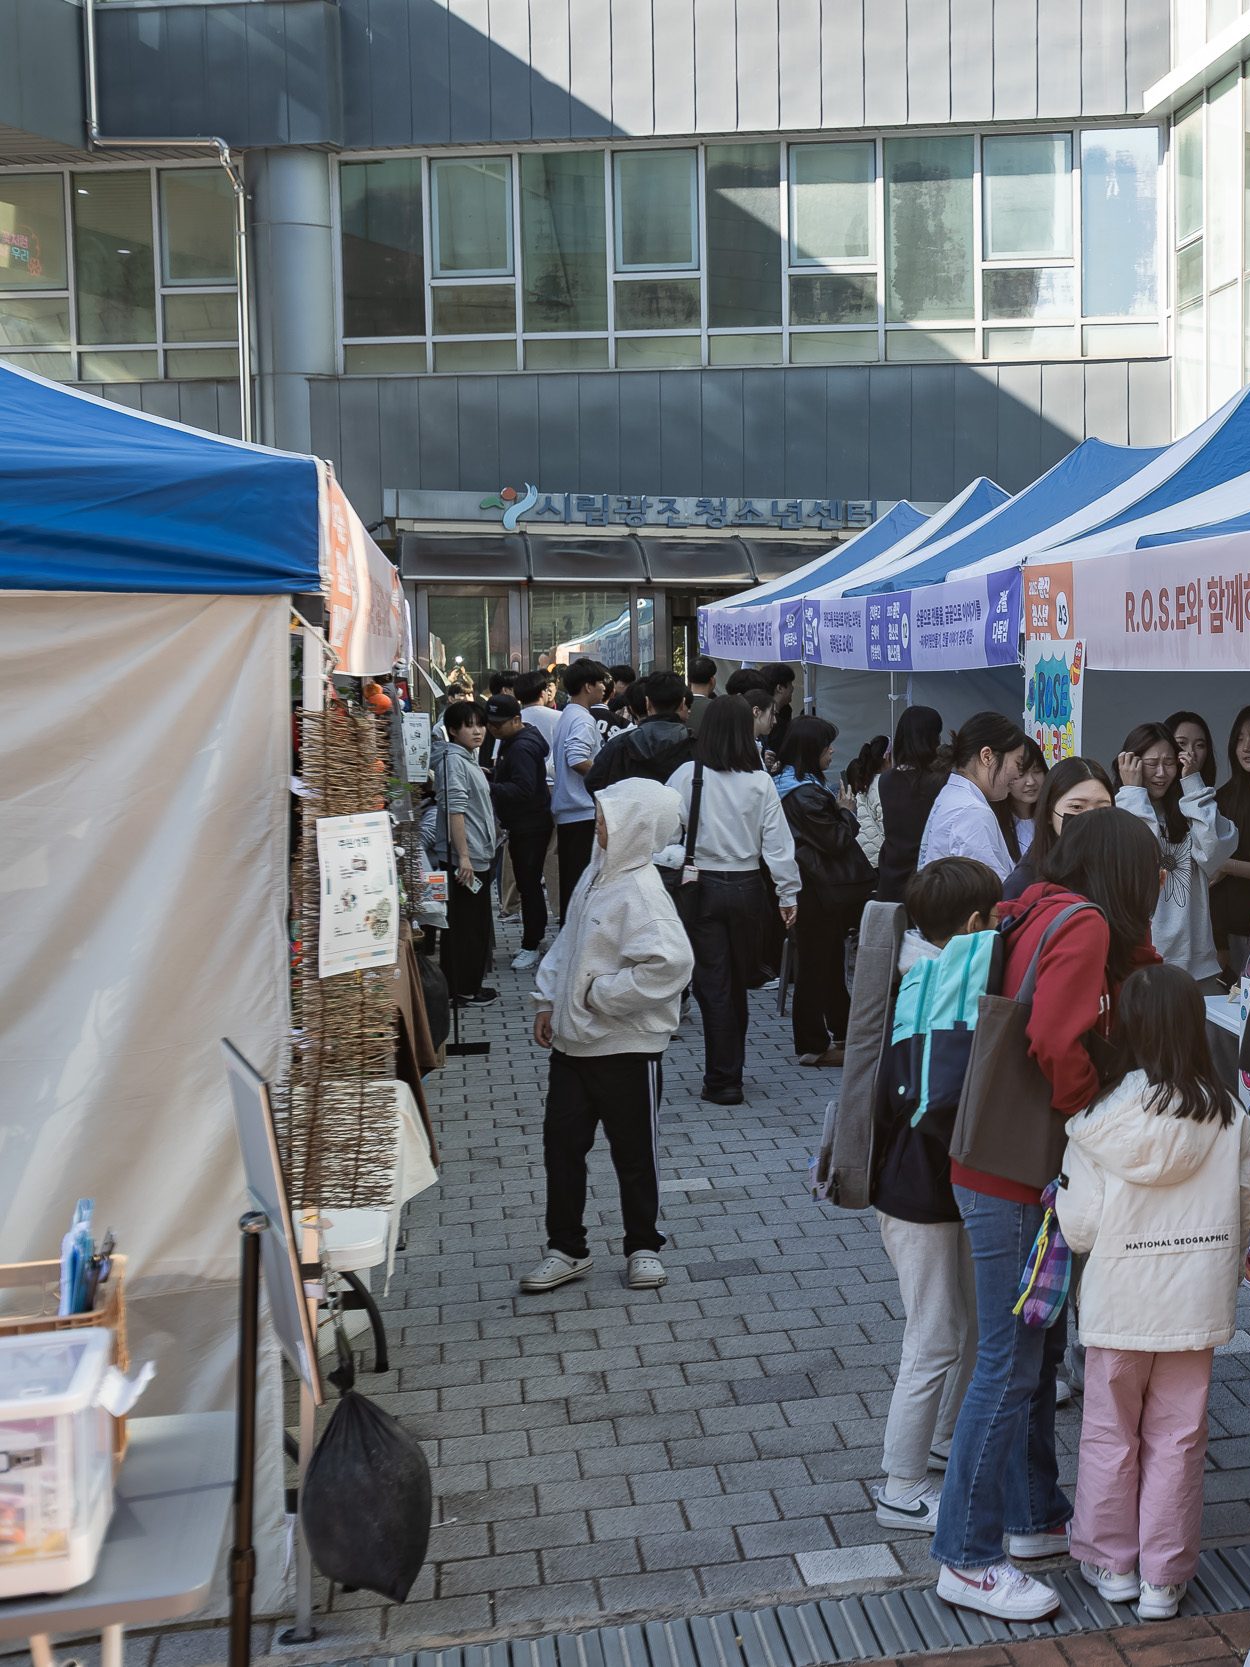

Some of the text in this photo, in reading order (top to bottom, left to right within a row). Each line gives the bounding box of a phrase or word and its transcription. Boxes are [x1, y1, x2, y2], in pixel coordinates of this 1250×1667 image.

[11, 246, 30, 263] 우리
[1032, 604, 1049, 627] 청소년
[1057, 604, 1067, 625] 43
[1124, 577, 1203, 635] R.O.S.E와
[1038, 671, 1069, 720] ROSE
[1125, 1233, 1229, 1251] NATIONAL GEOGRAPHIC
